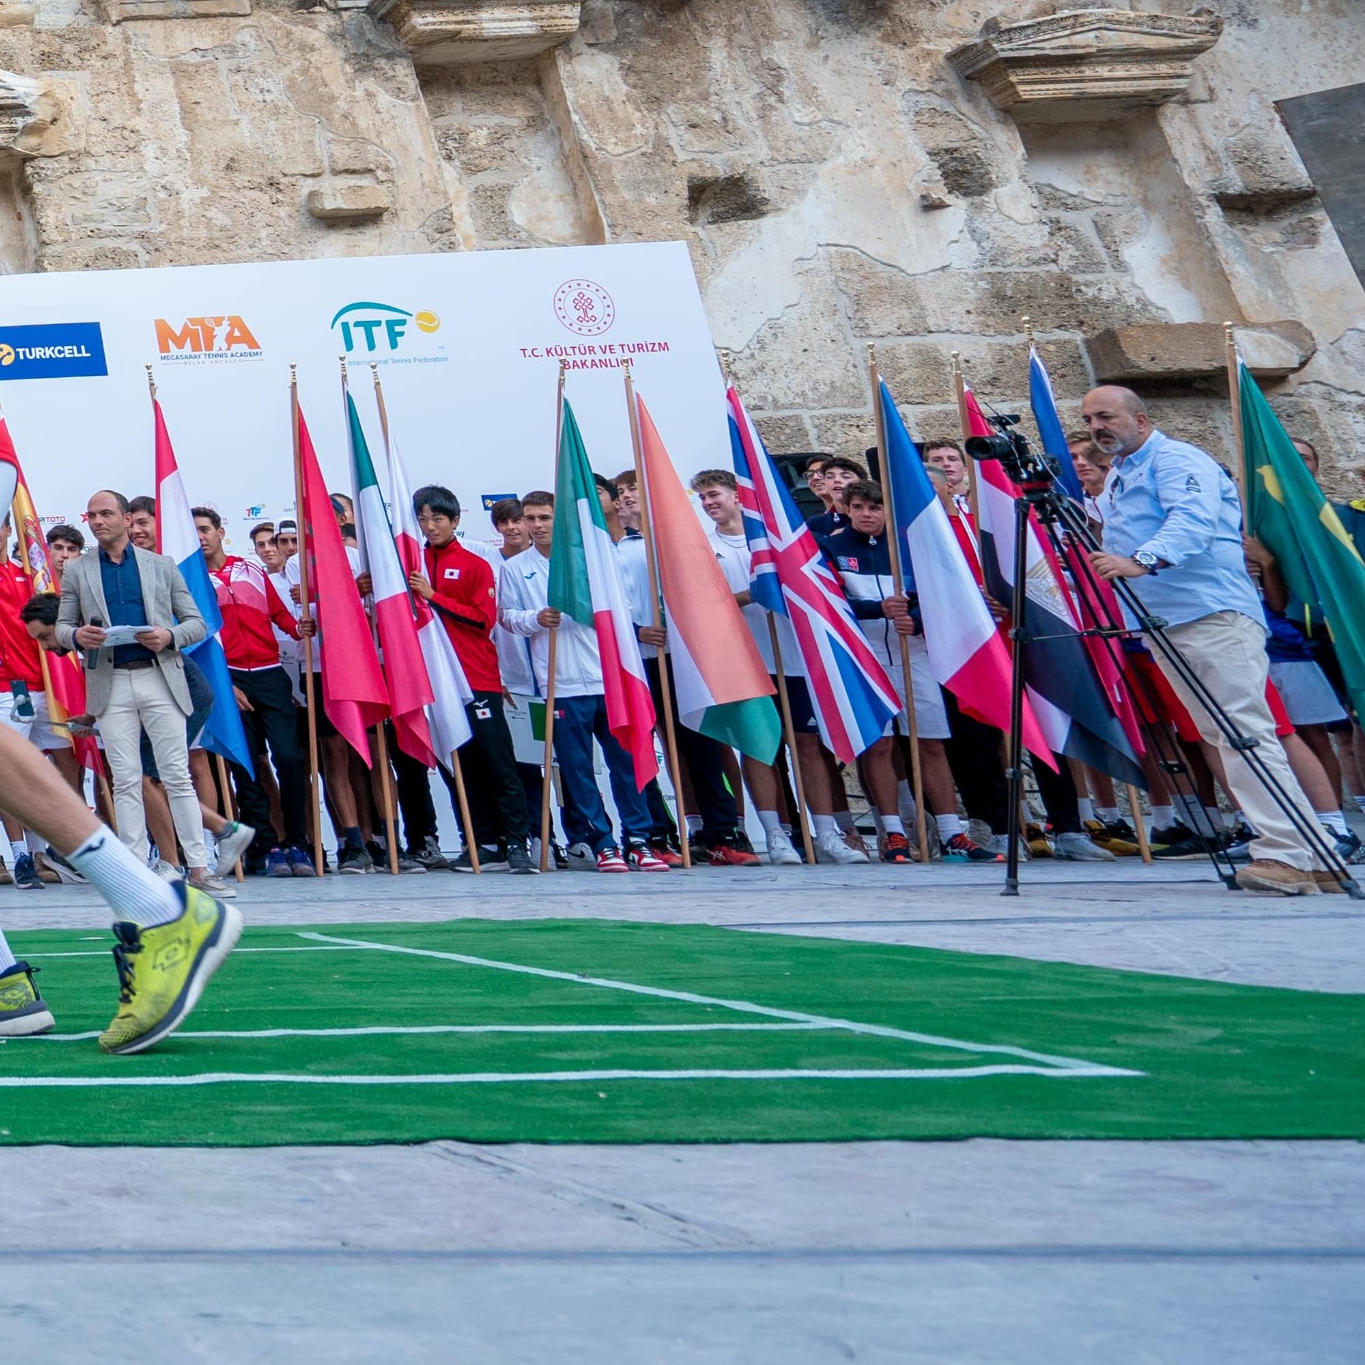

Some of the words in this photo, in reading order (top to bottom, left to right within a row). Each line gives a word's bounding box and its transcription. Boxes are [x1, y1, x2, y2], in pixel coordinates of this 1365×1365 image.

[341, 319, 408, 352] ITF
[16, 345, 91, 361] TURKCELL
[203, 352, 226, 360] TENNIS
[226, 350, 264, 358] ACADEMY
[520, 348, 543, 359] T.C.
[545, 344, 596, 358] KÜLTÜR
[599, 344, 617, 355] VE
[618, 341, 670, 353] TURİZM
[390, 357, 412, 365] Tennis
[413, 355, 449, 364] Federation
[563, 356, 634, 370] BAKANLII
